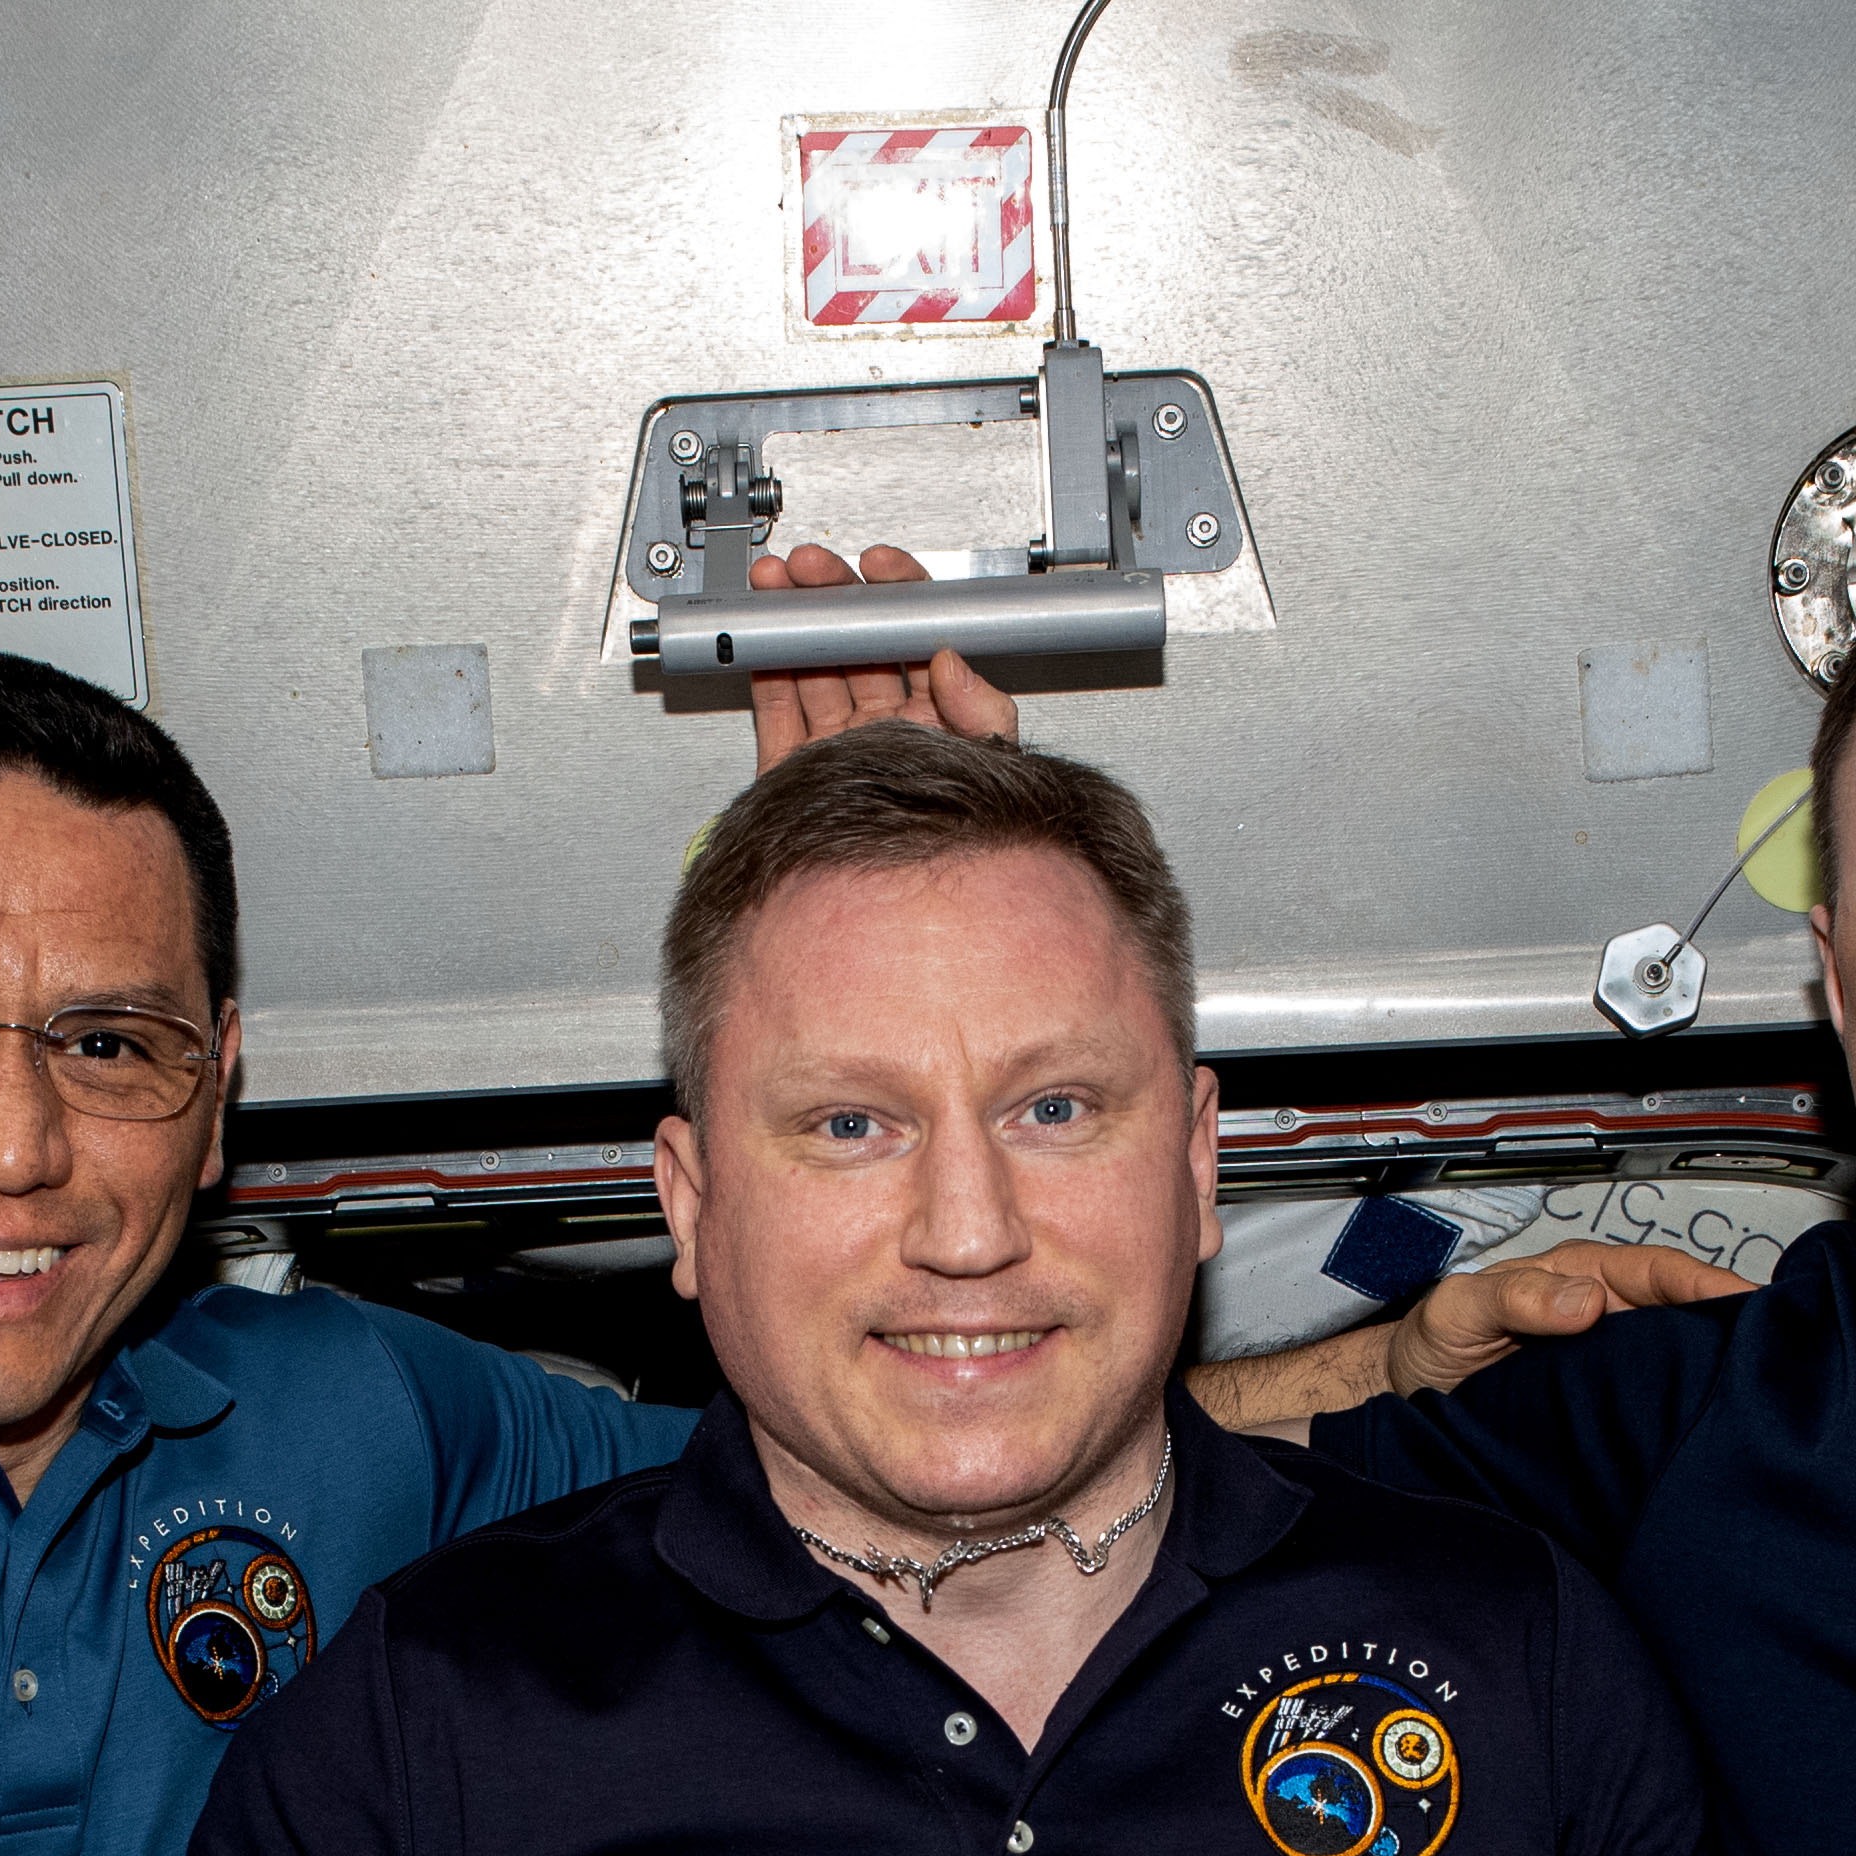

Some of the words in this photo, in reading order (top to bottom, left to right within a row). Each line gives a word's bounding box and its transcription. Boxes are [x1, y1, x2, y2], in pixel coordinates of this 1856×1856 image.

[27, 471, 78, 486] down.
[38, 594, 112, 611] direction
[1221, 1641, 1458, 1719] EXPEDITION
